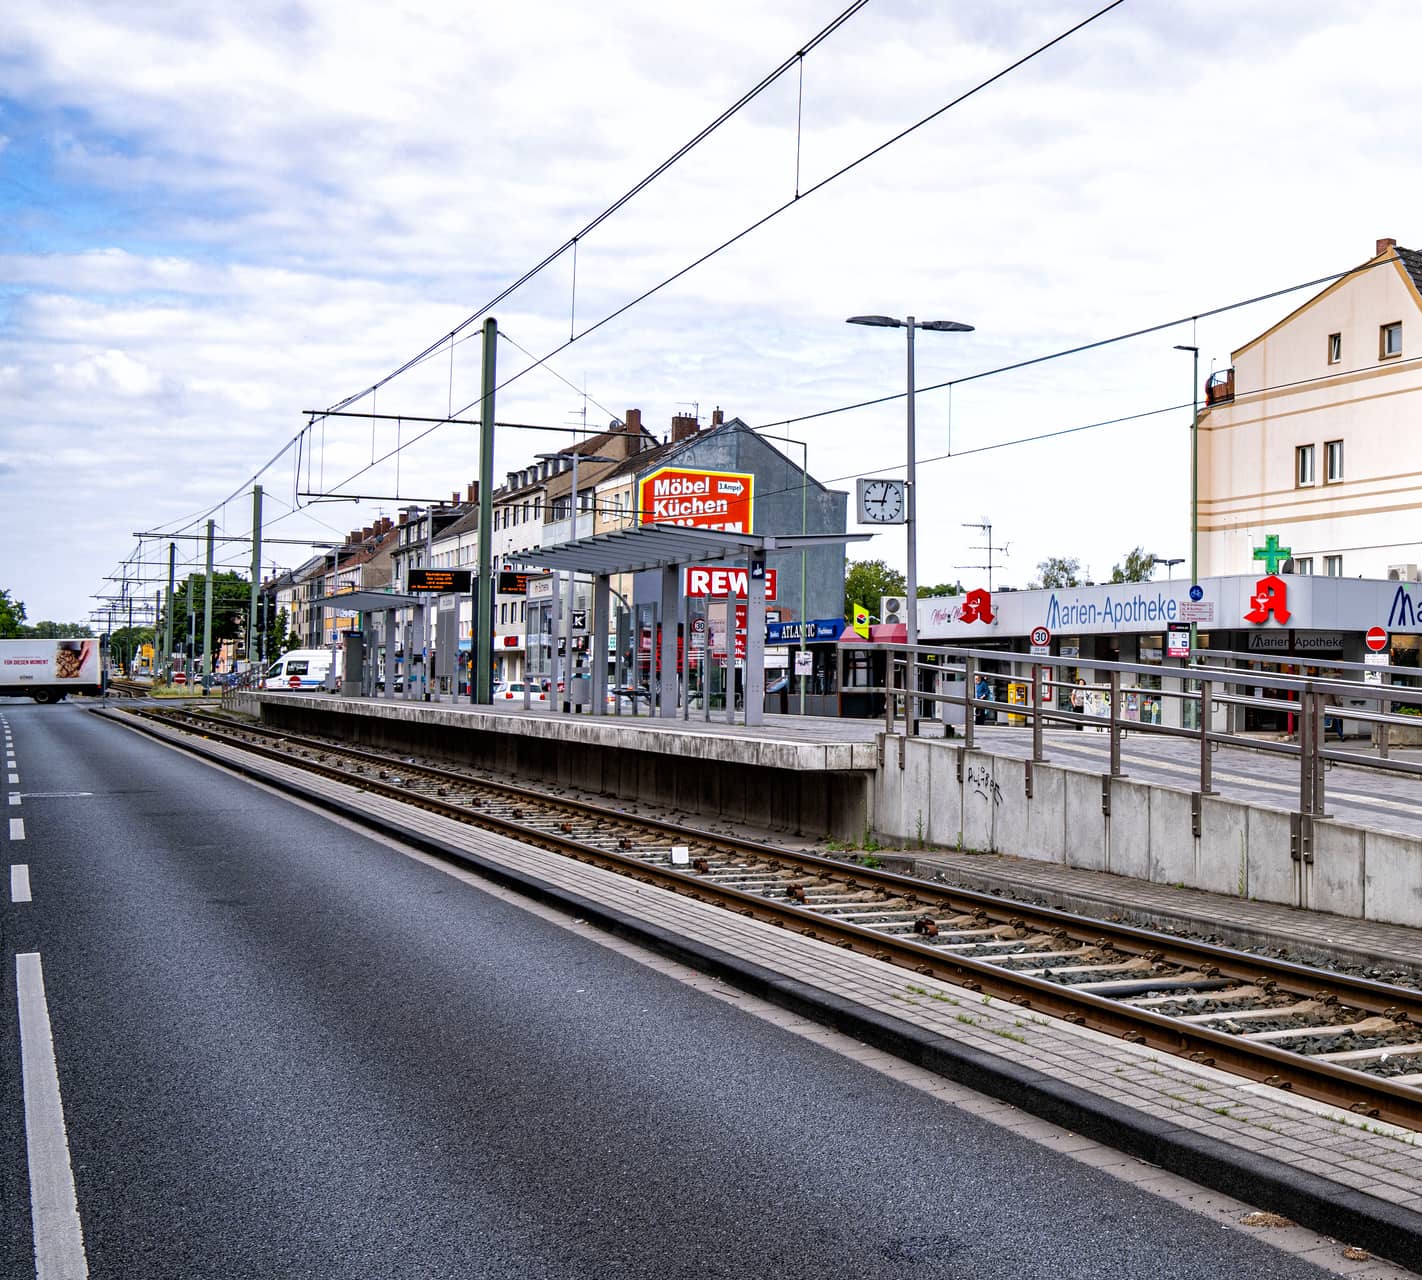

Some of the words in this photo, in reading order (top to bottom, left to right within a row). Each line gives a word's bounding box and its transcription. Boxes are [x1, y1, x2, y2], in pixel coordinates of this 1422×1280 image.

[654, 477, 710, 496] Möbel
[654, 497, 728, 517] Küchen
[1045, 593, 1177, 629] Marien-Apotheke
[781, 623, 815, 638] ATLATIC
[1035, 631, 1047, 642] 30
